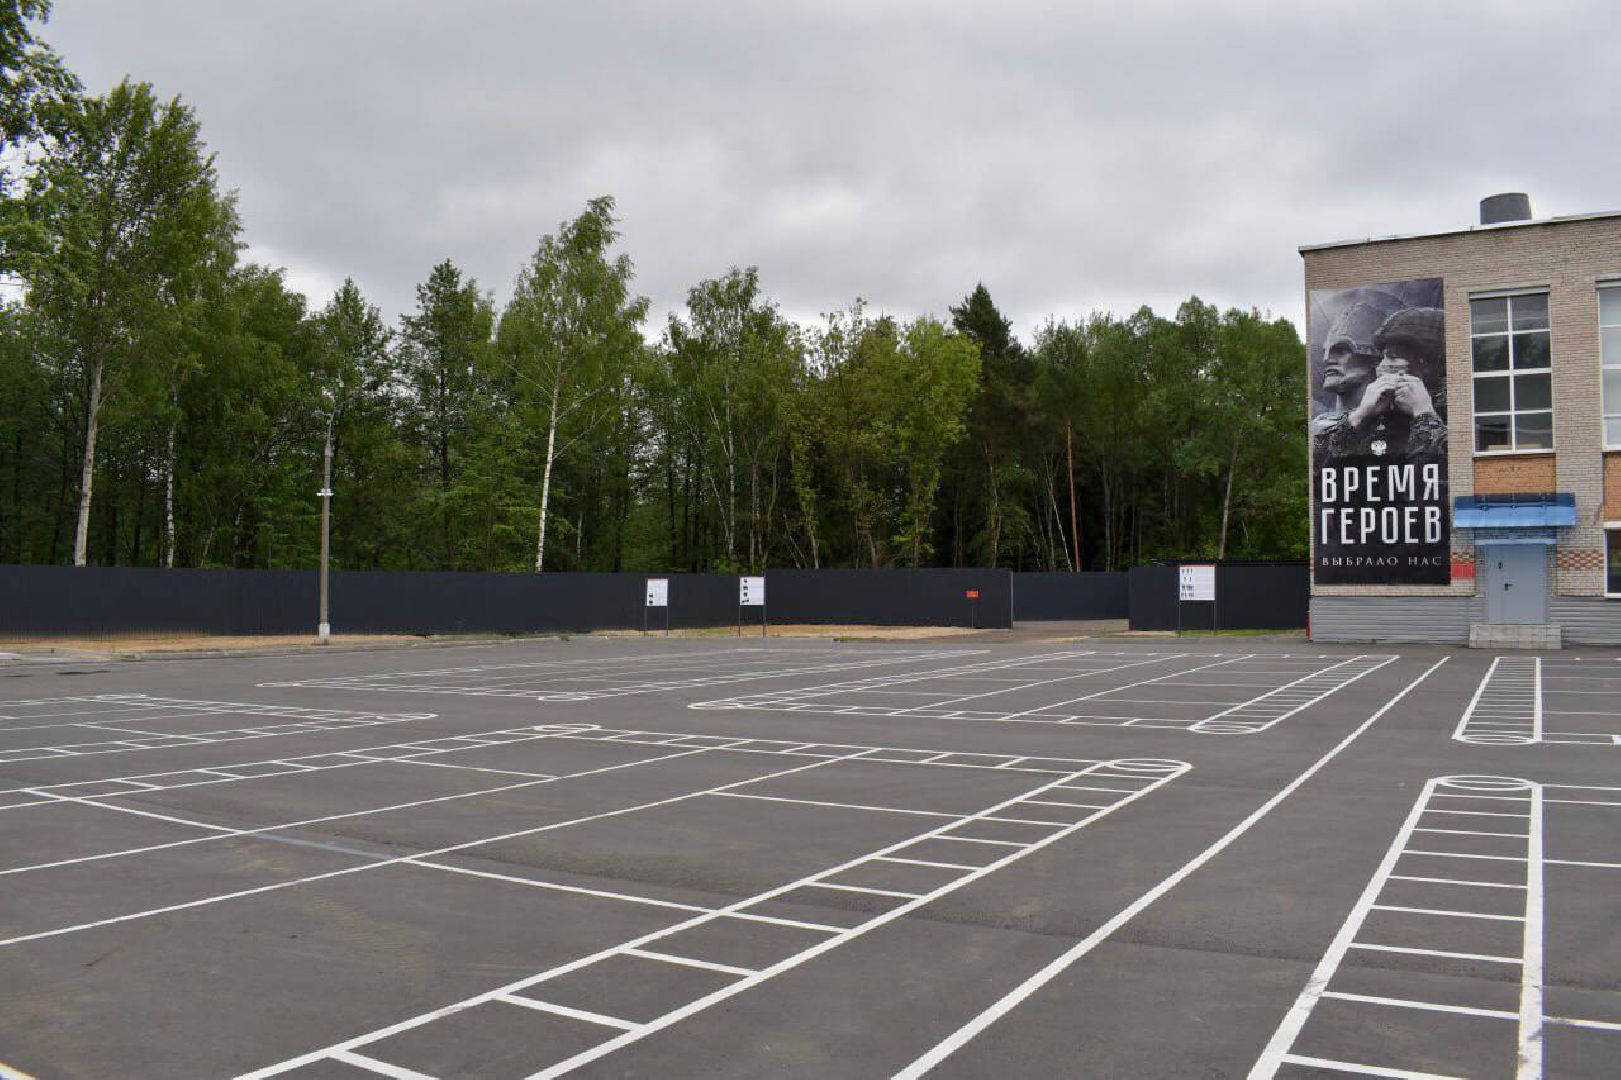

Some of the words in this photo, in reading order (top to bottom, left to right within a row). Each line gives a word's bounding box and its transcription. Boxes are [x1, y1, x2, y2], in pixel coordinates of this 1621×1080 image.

[1321, 463, 1440, 503] ВРЕМЯ
[1321, 506, 1442, 544] ГЕРОЕВ
[1322, 556, 1399, 566] ВЫБРАЛО
[1408, 556, 1442, 566] НАС
